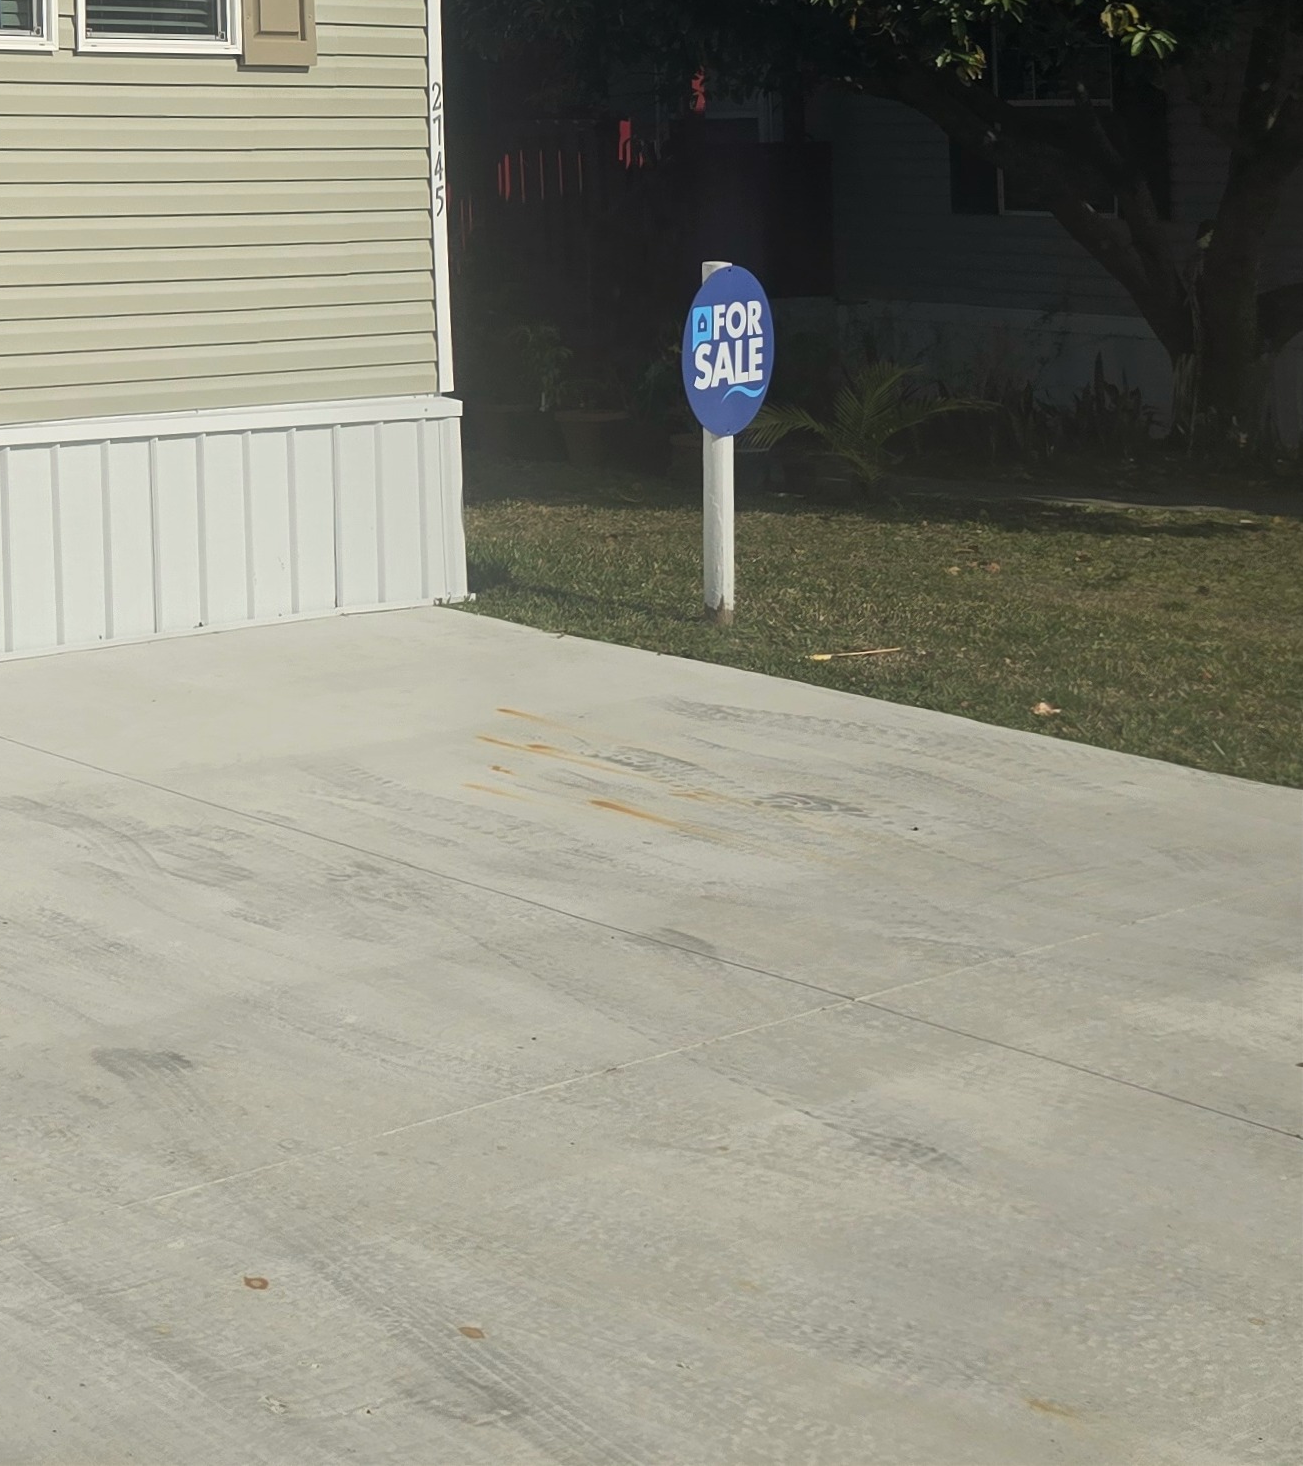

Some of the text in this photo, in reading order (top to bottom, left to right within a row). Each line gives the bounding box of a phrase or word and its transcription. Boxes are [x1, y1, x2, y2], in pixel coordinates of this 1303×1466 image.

[432, 82, 444, 217] 2745
[713, 300, 763, 341] FOR
[693, 336, 764, 391] SALE
